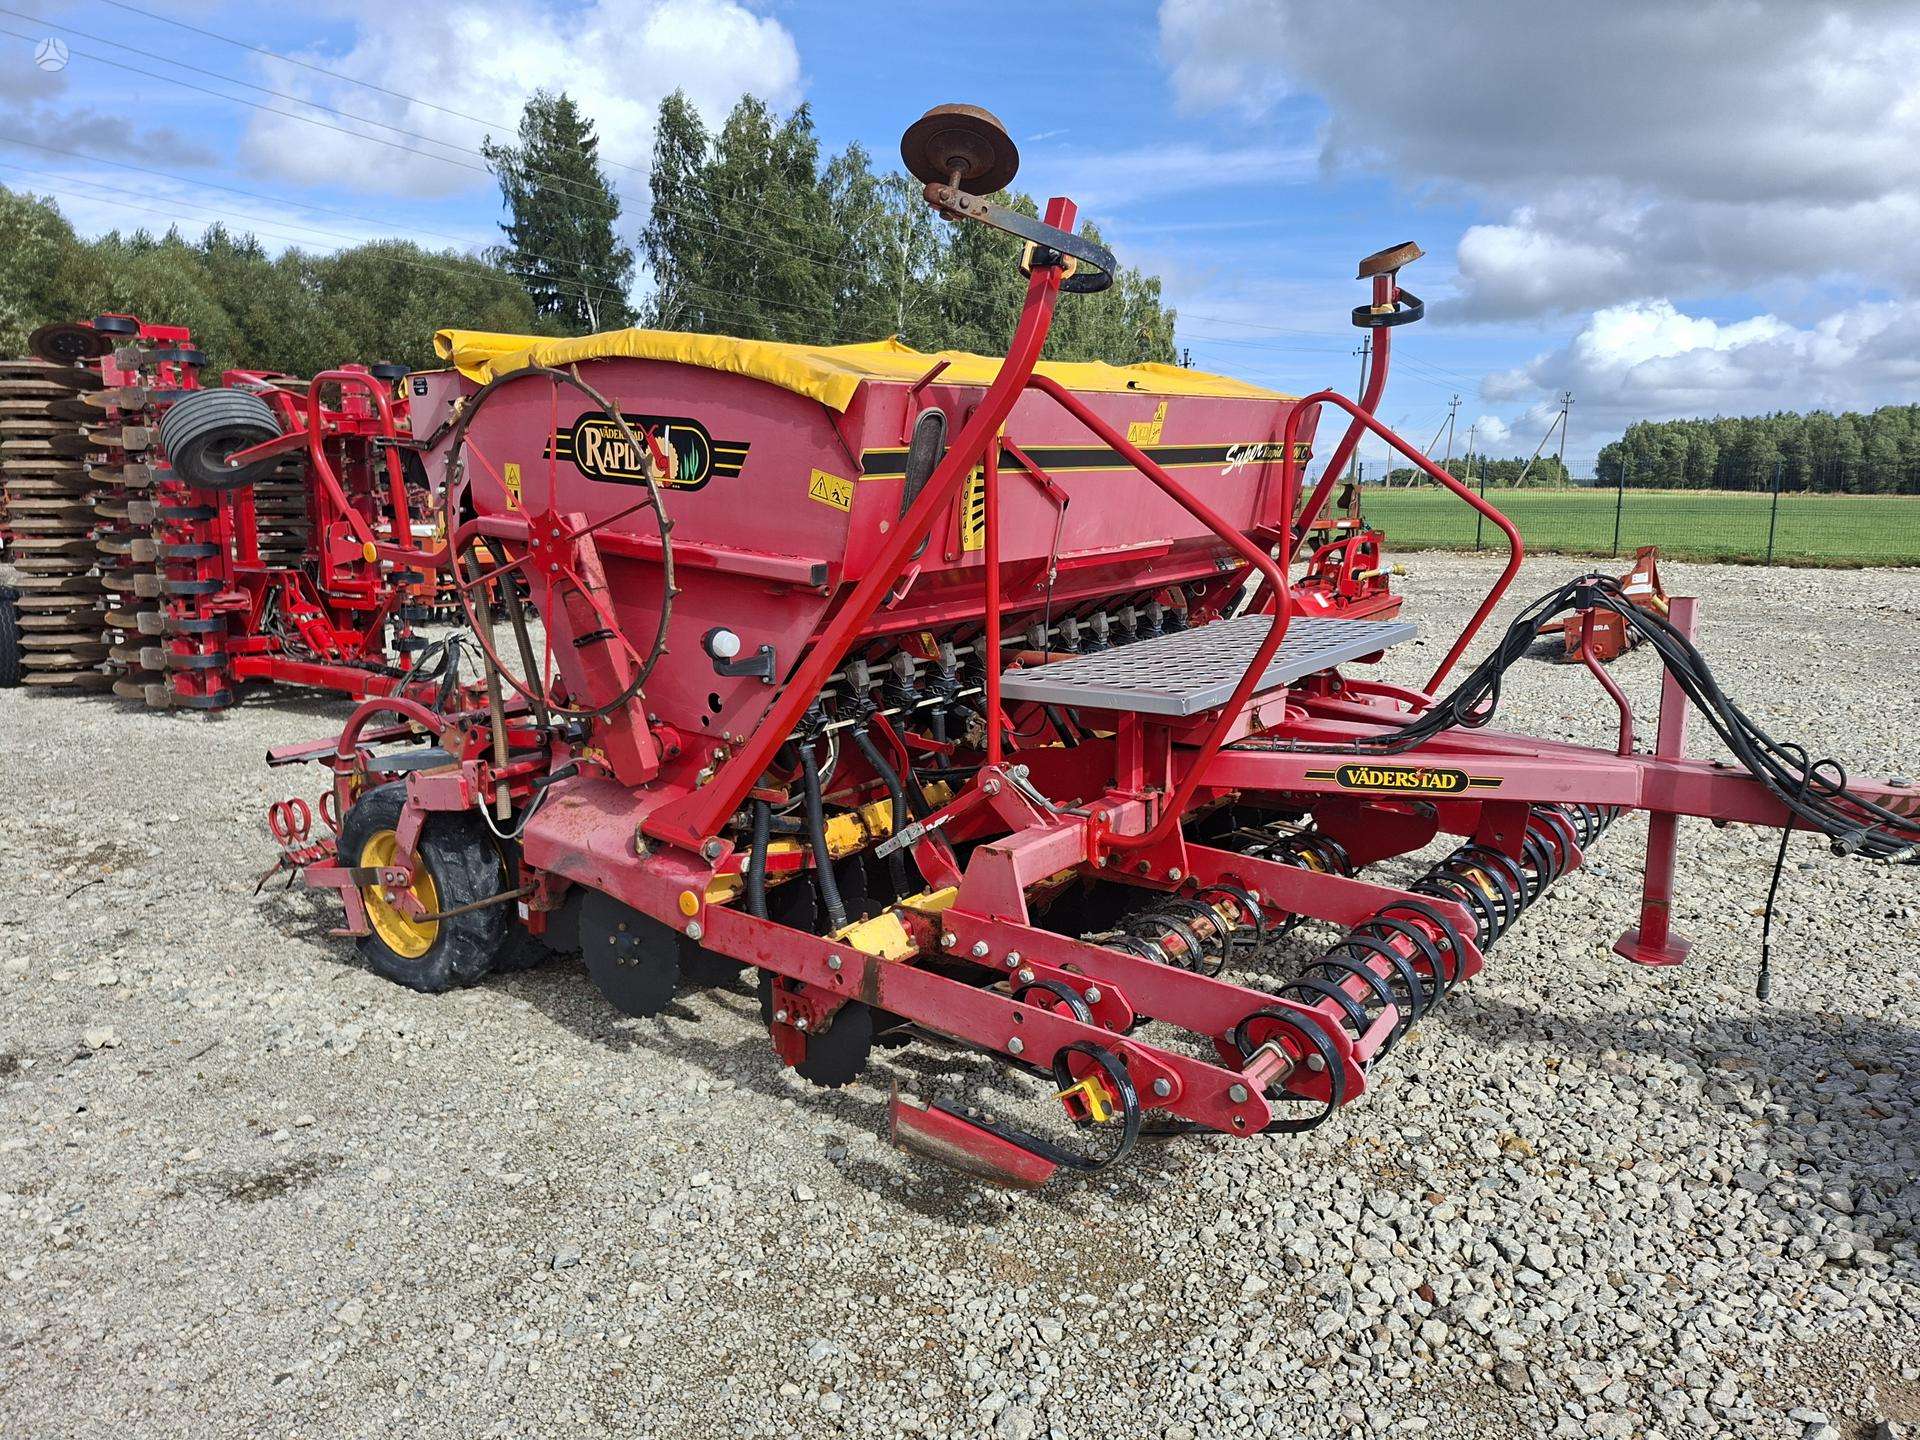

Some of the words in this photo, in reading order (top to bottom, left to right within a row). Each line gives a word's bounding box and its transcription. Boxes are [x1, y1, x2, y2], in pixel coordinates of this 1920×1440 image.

[599, 426, 644, 441] VÄDERAD
[1220, 443, 1265, 476] Super
[1262, 446, 1284, 460] Rapid
[1346, 766, 1457, 789] VÄDERSTAD
